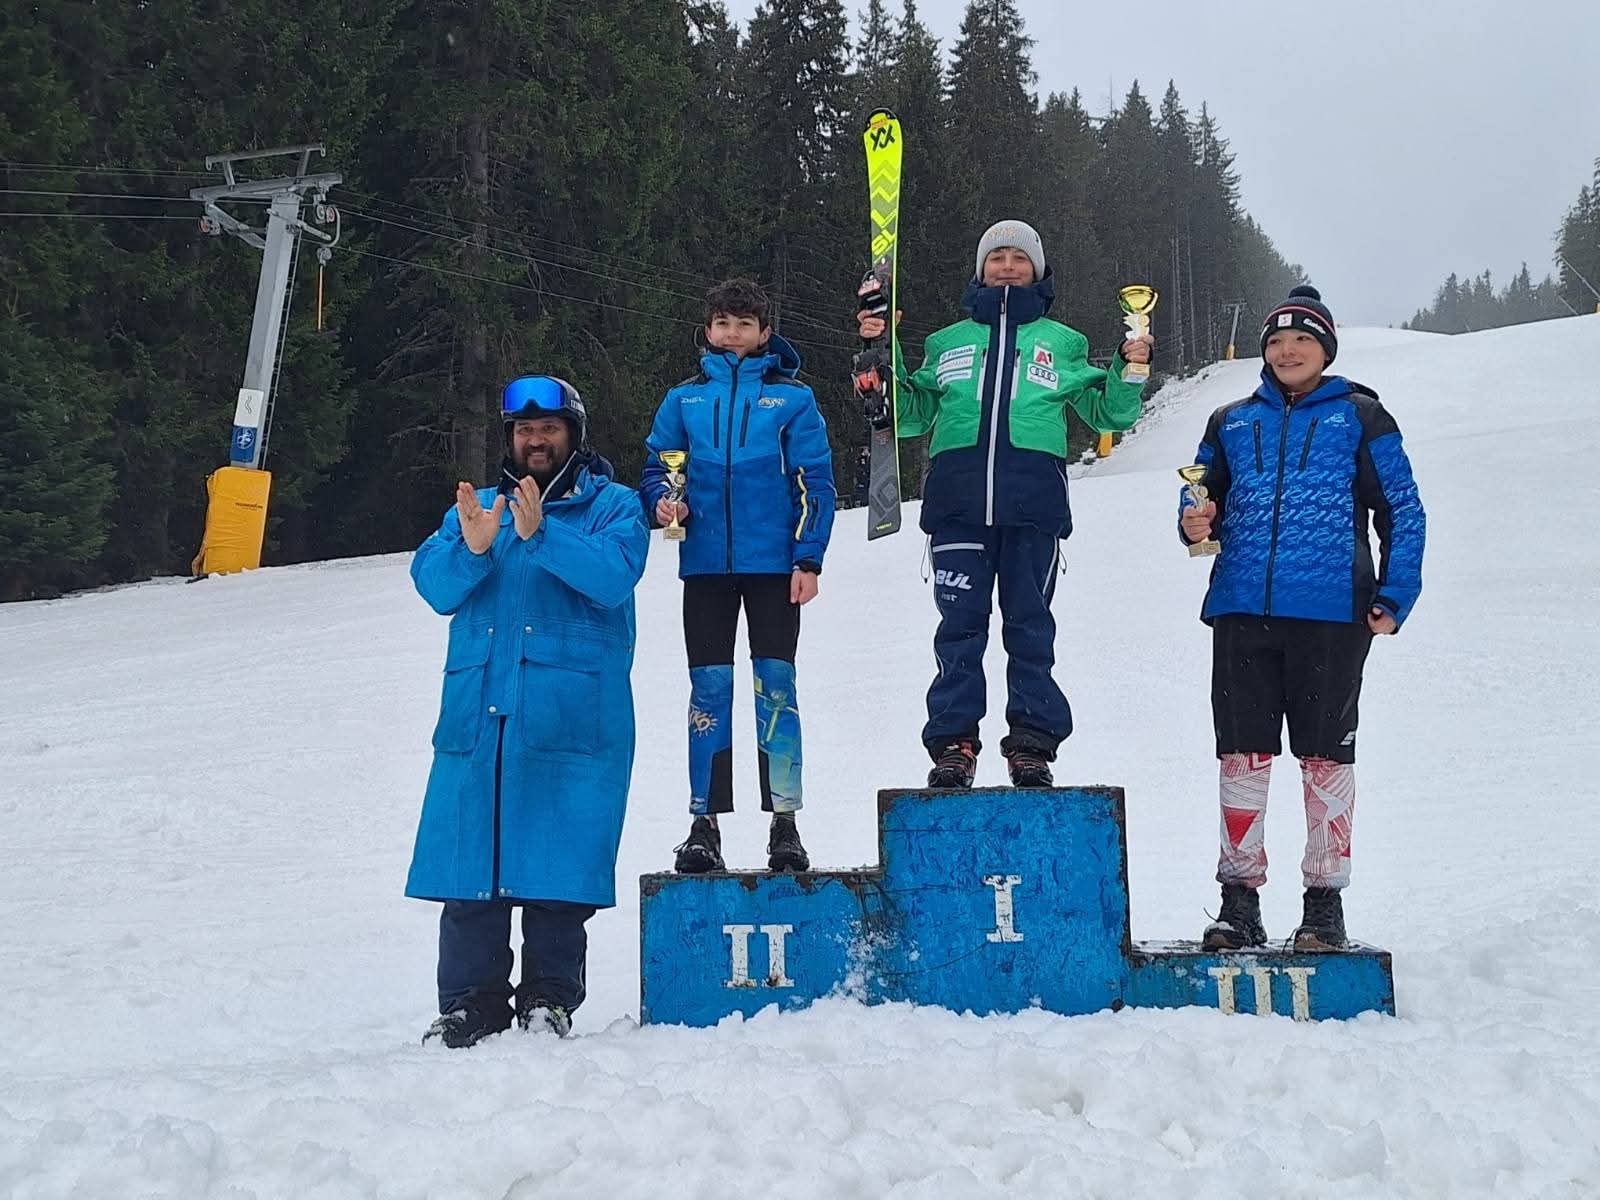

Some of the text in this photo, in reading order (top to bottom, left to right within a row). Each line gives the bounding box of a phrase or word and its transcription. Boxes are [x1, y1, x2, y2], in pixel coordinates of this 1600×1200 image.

[1036, 351, 1052, 365] A1
[936, 569, 972, 590] BUL
[983, 874, 1024, 943] I
[723, 924, 794, 988] II
[1208, 966, 1316, 1021] III
